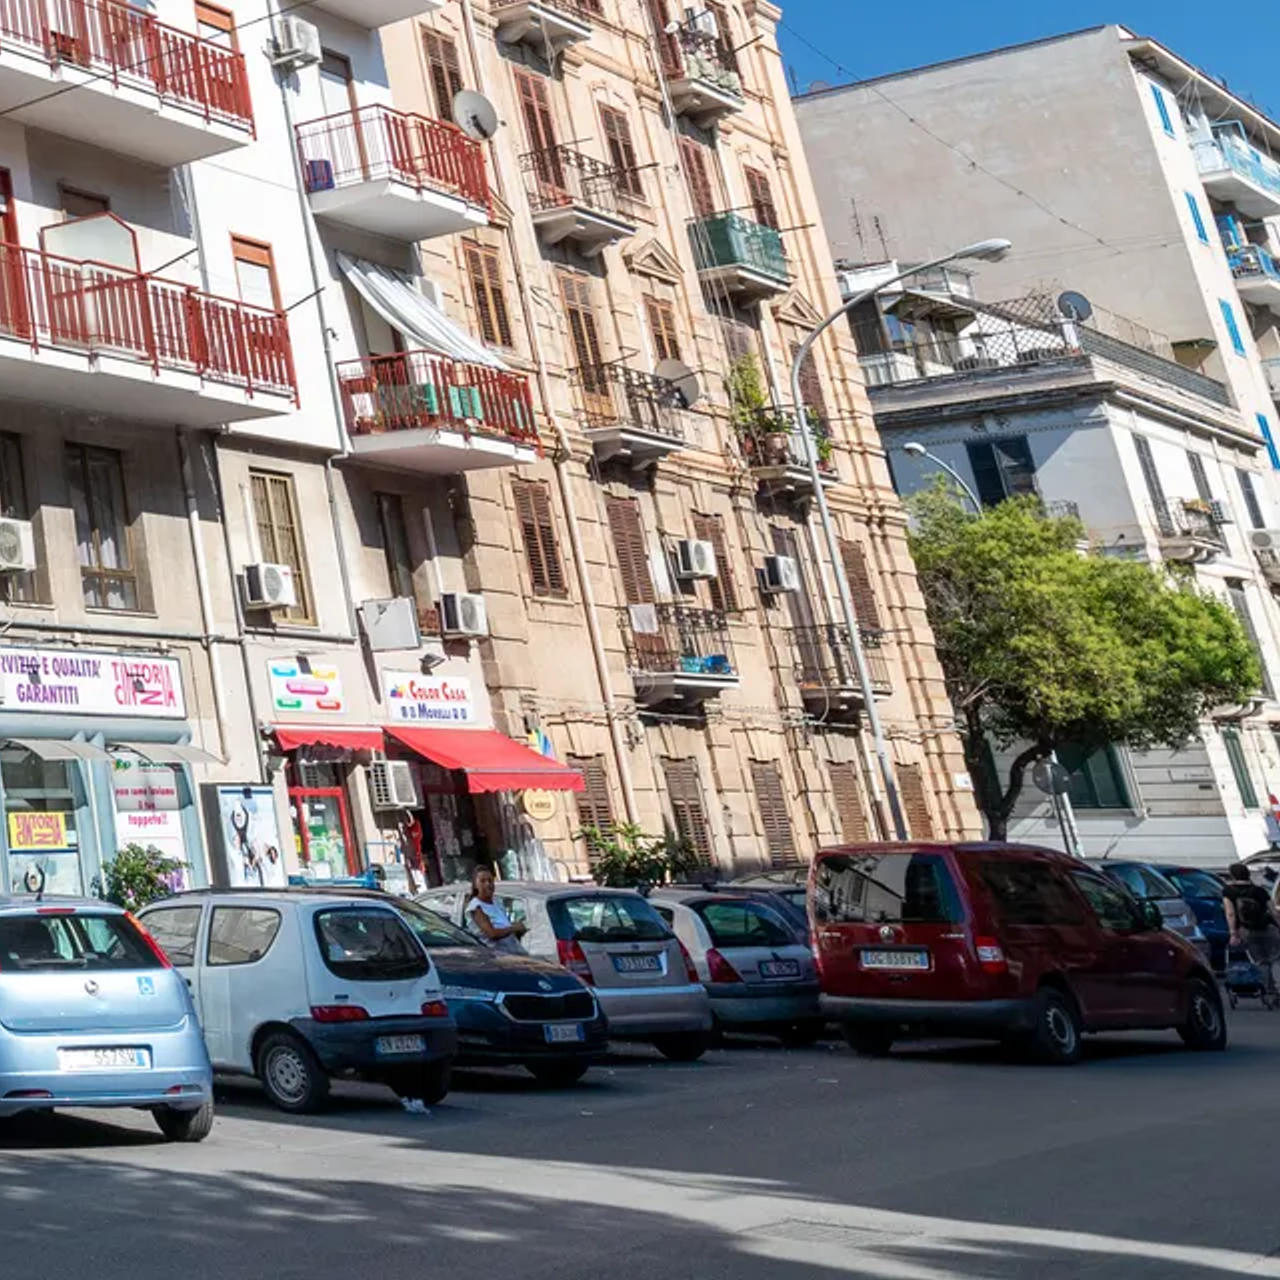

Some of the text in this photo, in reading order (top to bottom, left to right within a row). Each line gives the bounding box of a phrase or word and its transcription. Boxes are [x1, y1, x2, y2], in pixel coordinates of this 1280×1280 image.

[42, 656, 50, 675] E
[52, 657, 102, 678] QUALITA'
[16, 683, 79, 705] GARANTITI
